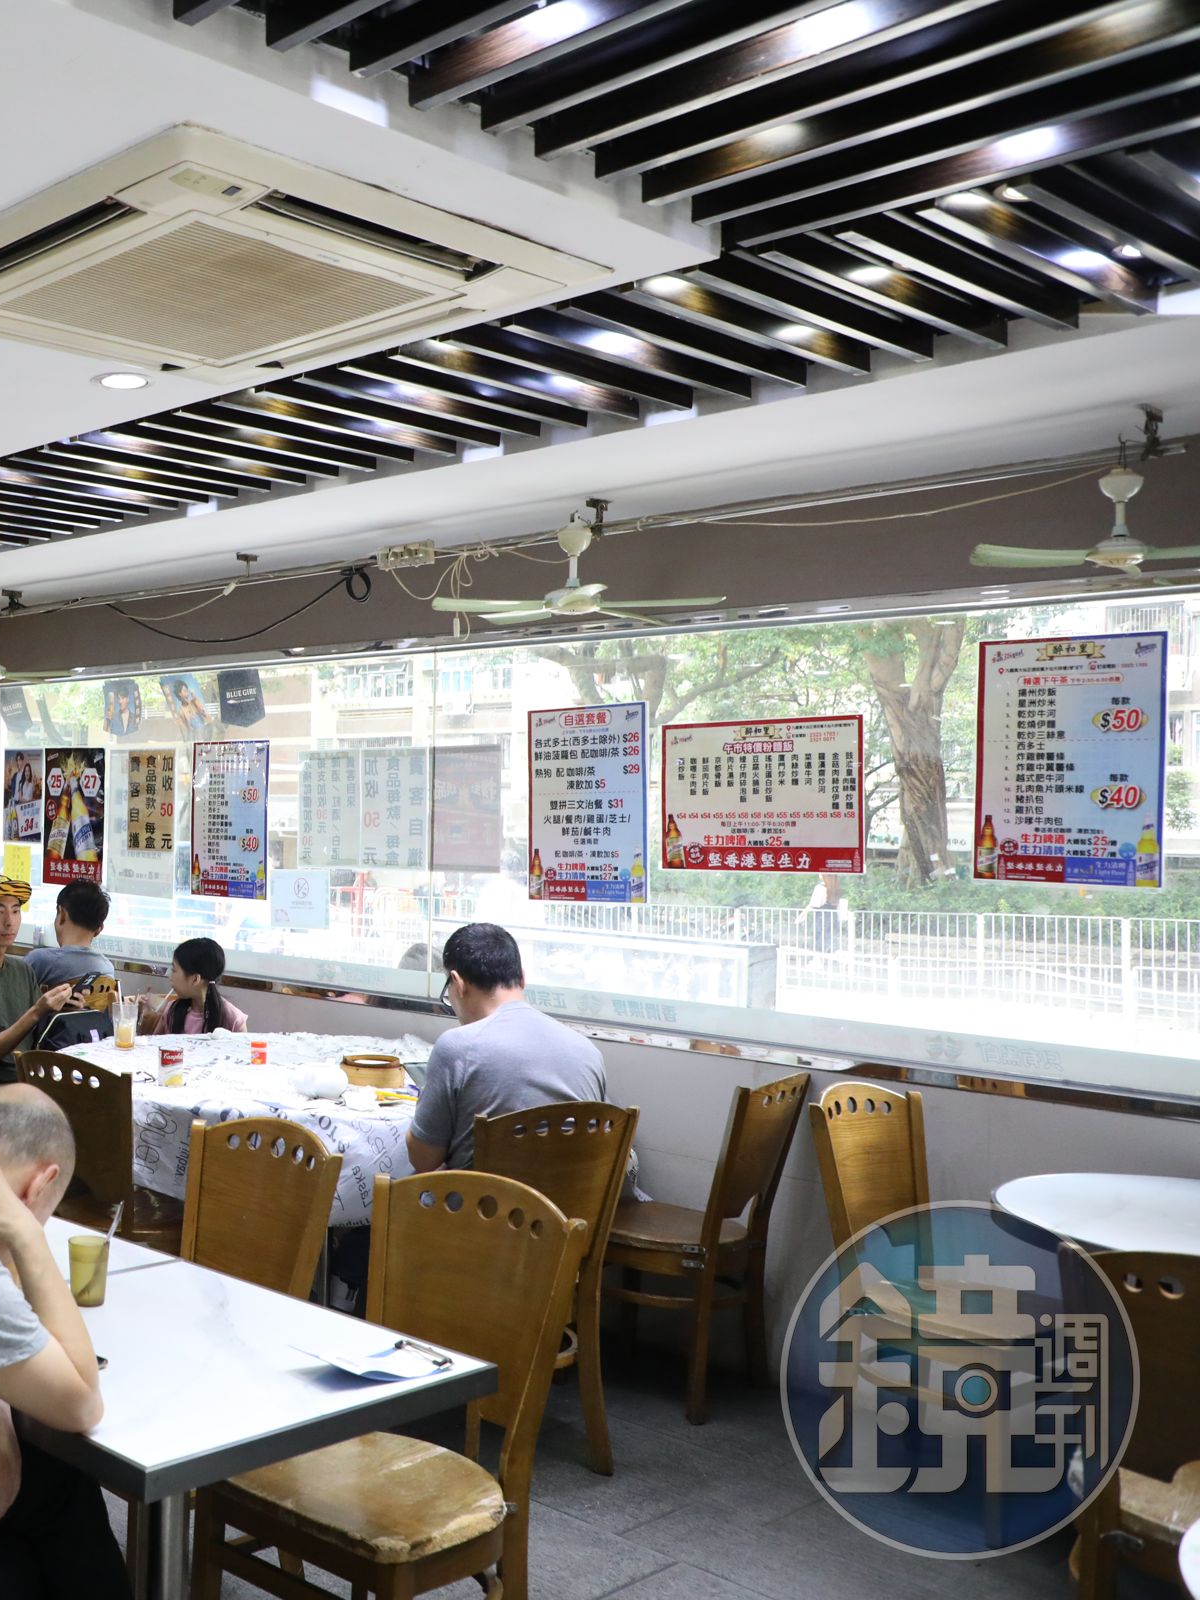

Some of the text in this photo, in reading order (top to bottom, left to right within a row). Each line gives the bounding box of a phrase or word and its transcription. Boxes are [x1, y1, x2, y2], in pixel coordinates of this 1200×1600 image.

[1023, 676, 1069, 686] 精選下午茶
[226, 687, 257, 699] BLUE GIRL
[1018, 687, 1057, 698] 揚州炒飯
[1018, 698, 1056, 708] 星洲炒米
[1111, 696, 1131, 706] 每款
[564, 711, 607, 726] 自選套餐
[1017, 709, 1056, 719] 乾炒牛河
[1100, 708, 1143, 731] $50
[1017, 720, 1056, 729] 乾燒伊麵
[535, 732, 640, 749] 各式多士(西多士除外) $26
[1016, 741, 1045, 751] 西多士
[723, 739, 794, 755] 午市特價粉麵飯
[534, 746, 640, 761] 鮮油菠蘿包 配咖啡/茶 $26
[535, 768, 552, 779] 熱狗
[566, 766, 596, 777] 咖啡/茶
[622, 763, 640, 775] $29
[1015, 773, 1065, 783] 越式肥牛河
[1109, 773, 1129, 783] 每款
[566, 778, 606, 790] 凍飲加 $5
[1015, 795, 1044, 805] 豬扒包
[1098, 785, 1141, 808] $40
[549, 798, 624, 810] 雙拼三文治餐 $31
[1015, 805, 1044, 815] 雞扒包
[561, 827, 611, 837] 鮮茄/鹹牛肉
[241, 836, 258, 849] $40
[703, 835, 747, 847] 生力啤酒
[1021, 833, 1066, 845] 生力啤酒
[1020, 845, 1065, 856] 生力清啤
[558, 863, 586, 872] 生力啤酒
